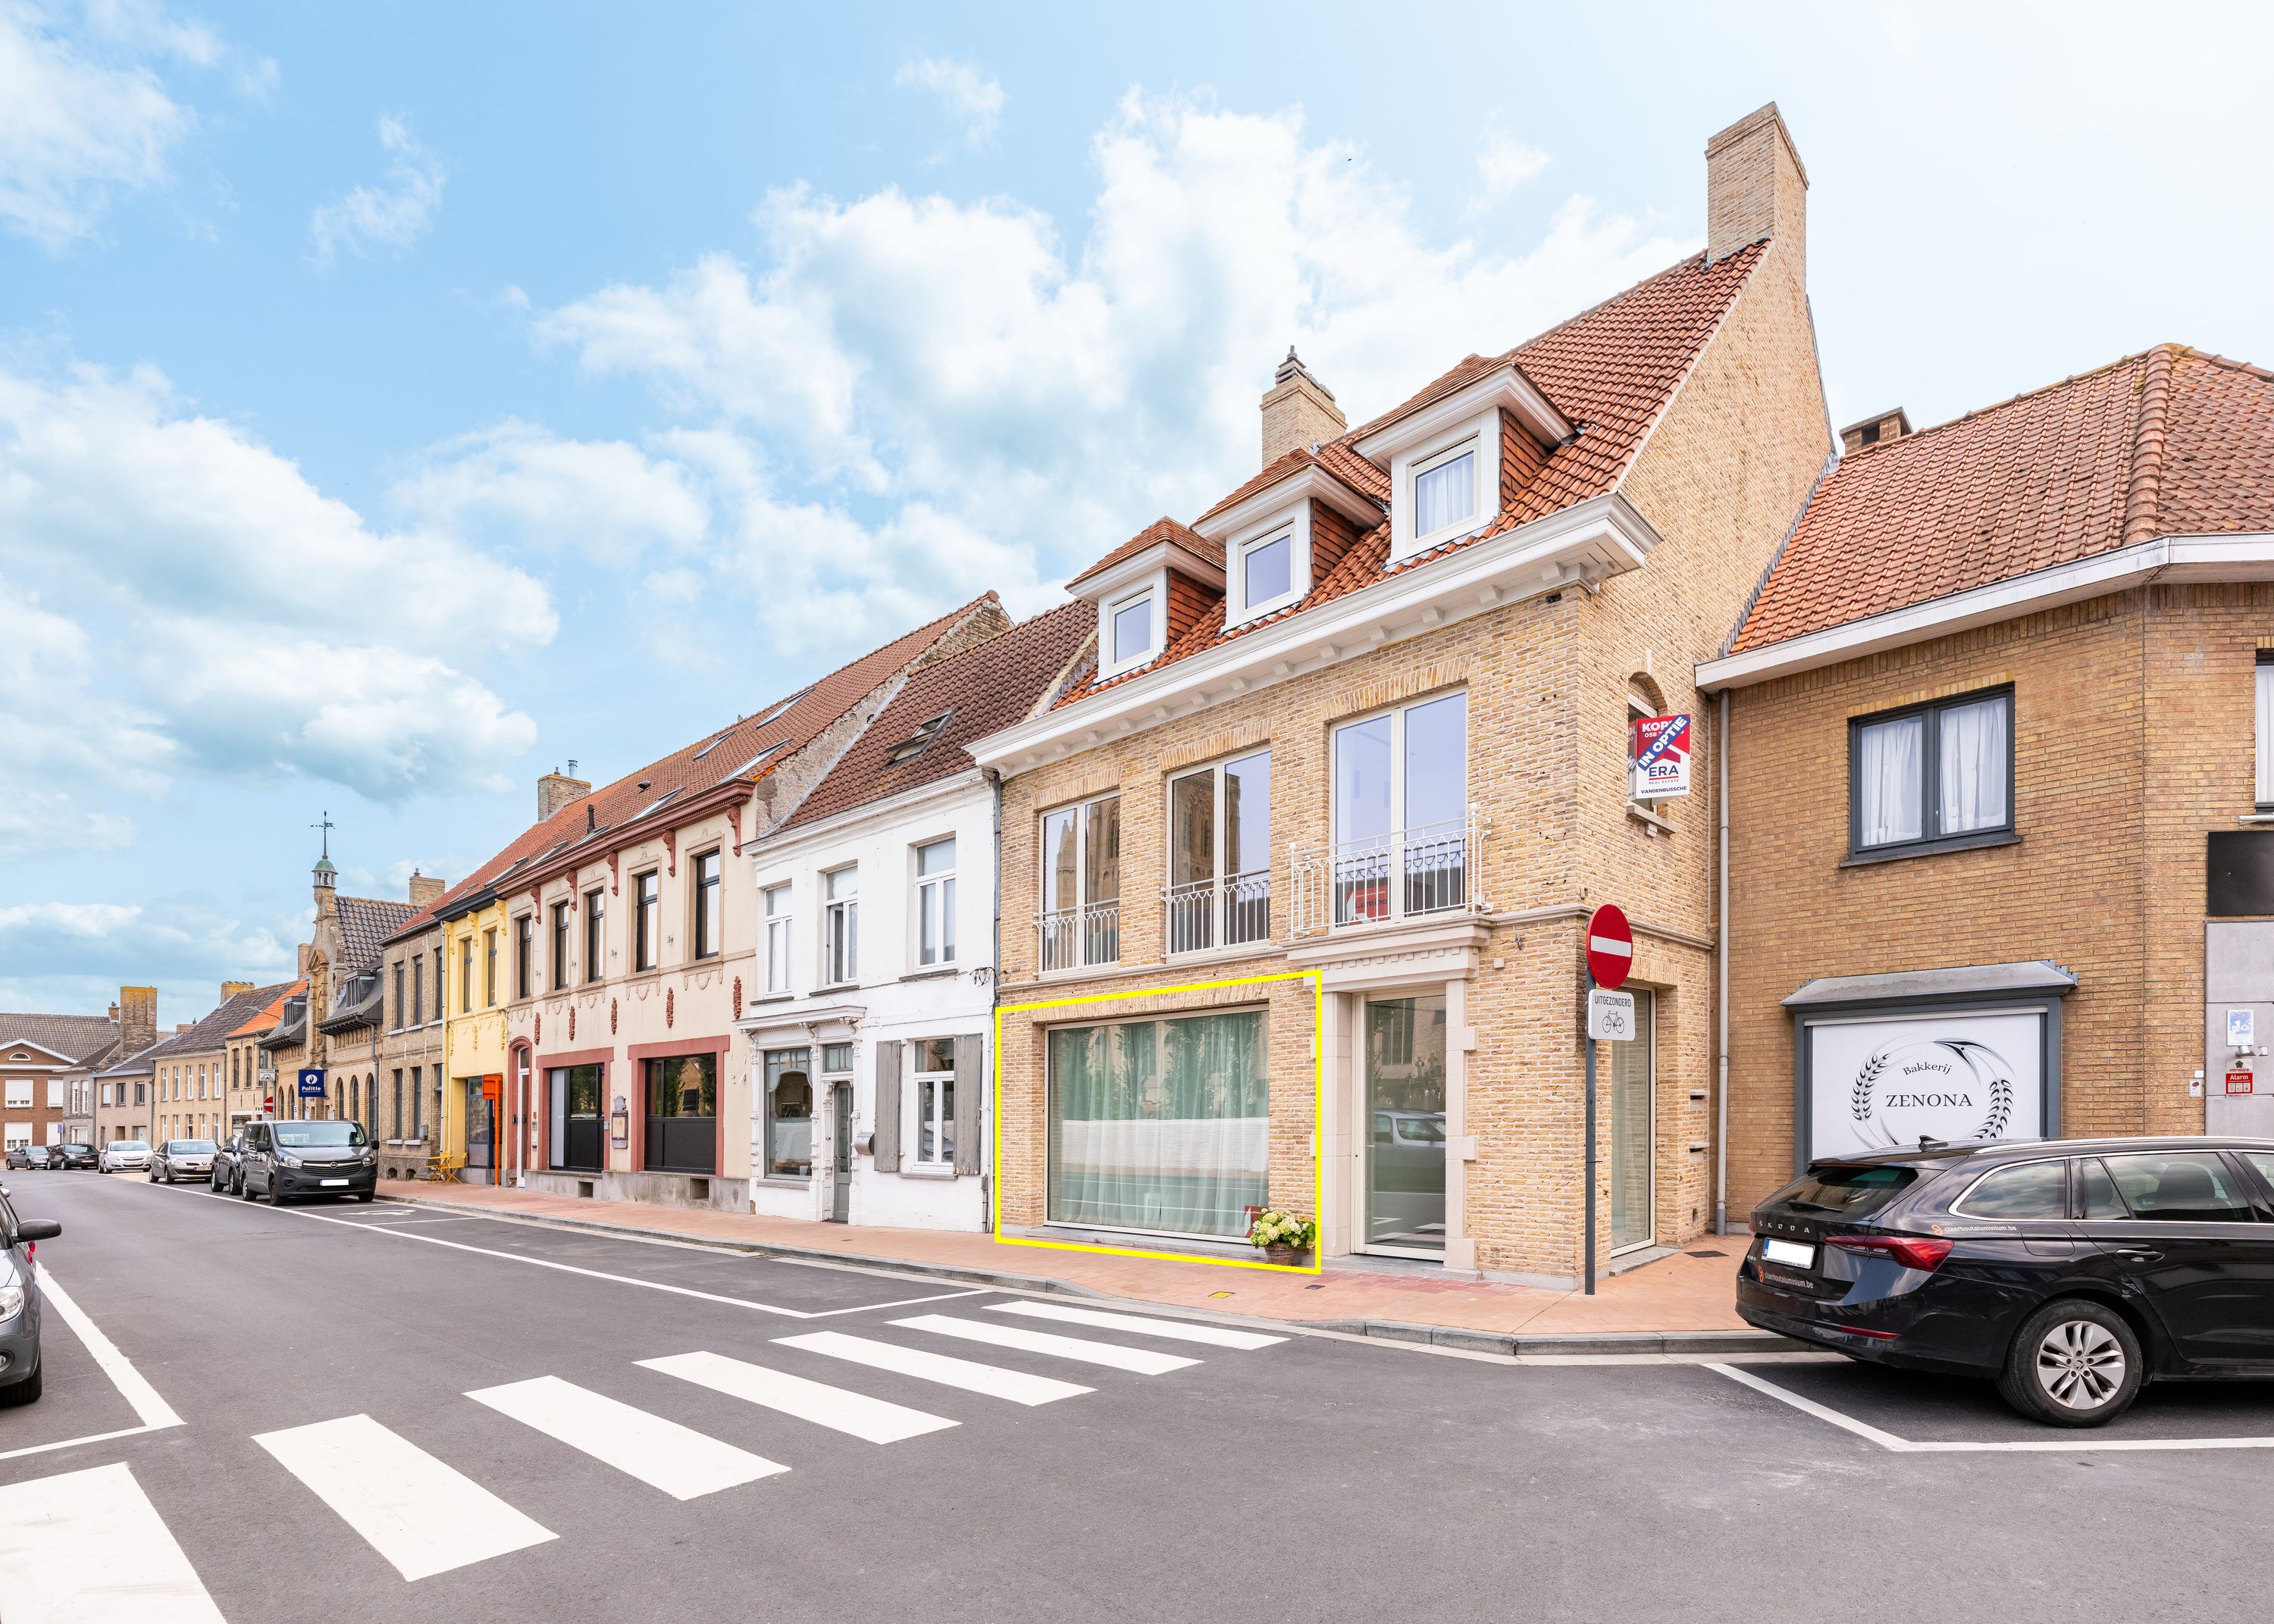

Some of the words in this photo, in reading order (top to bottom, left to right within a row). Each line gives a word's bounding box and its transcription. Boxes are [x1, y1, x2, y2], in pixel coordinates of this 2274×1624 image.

[1638, 751, 1655, 767] IN
[1652, 716, 1687, 753] OPTIE
[1649, 765, 1679, 777] ERA
[1641, 786, 1687, 794] VANDENBUSSCHE
[1594, 994, 1632, 1008] UITGEZONDERD
[1903, 1062, 1952, 1075] Bakkerij
[1885, 1094, 1974, 1107] ZENONA
[1765, 1272, 1814, 1289] claerhoutaluminium.be
